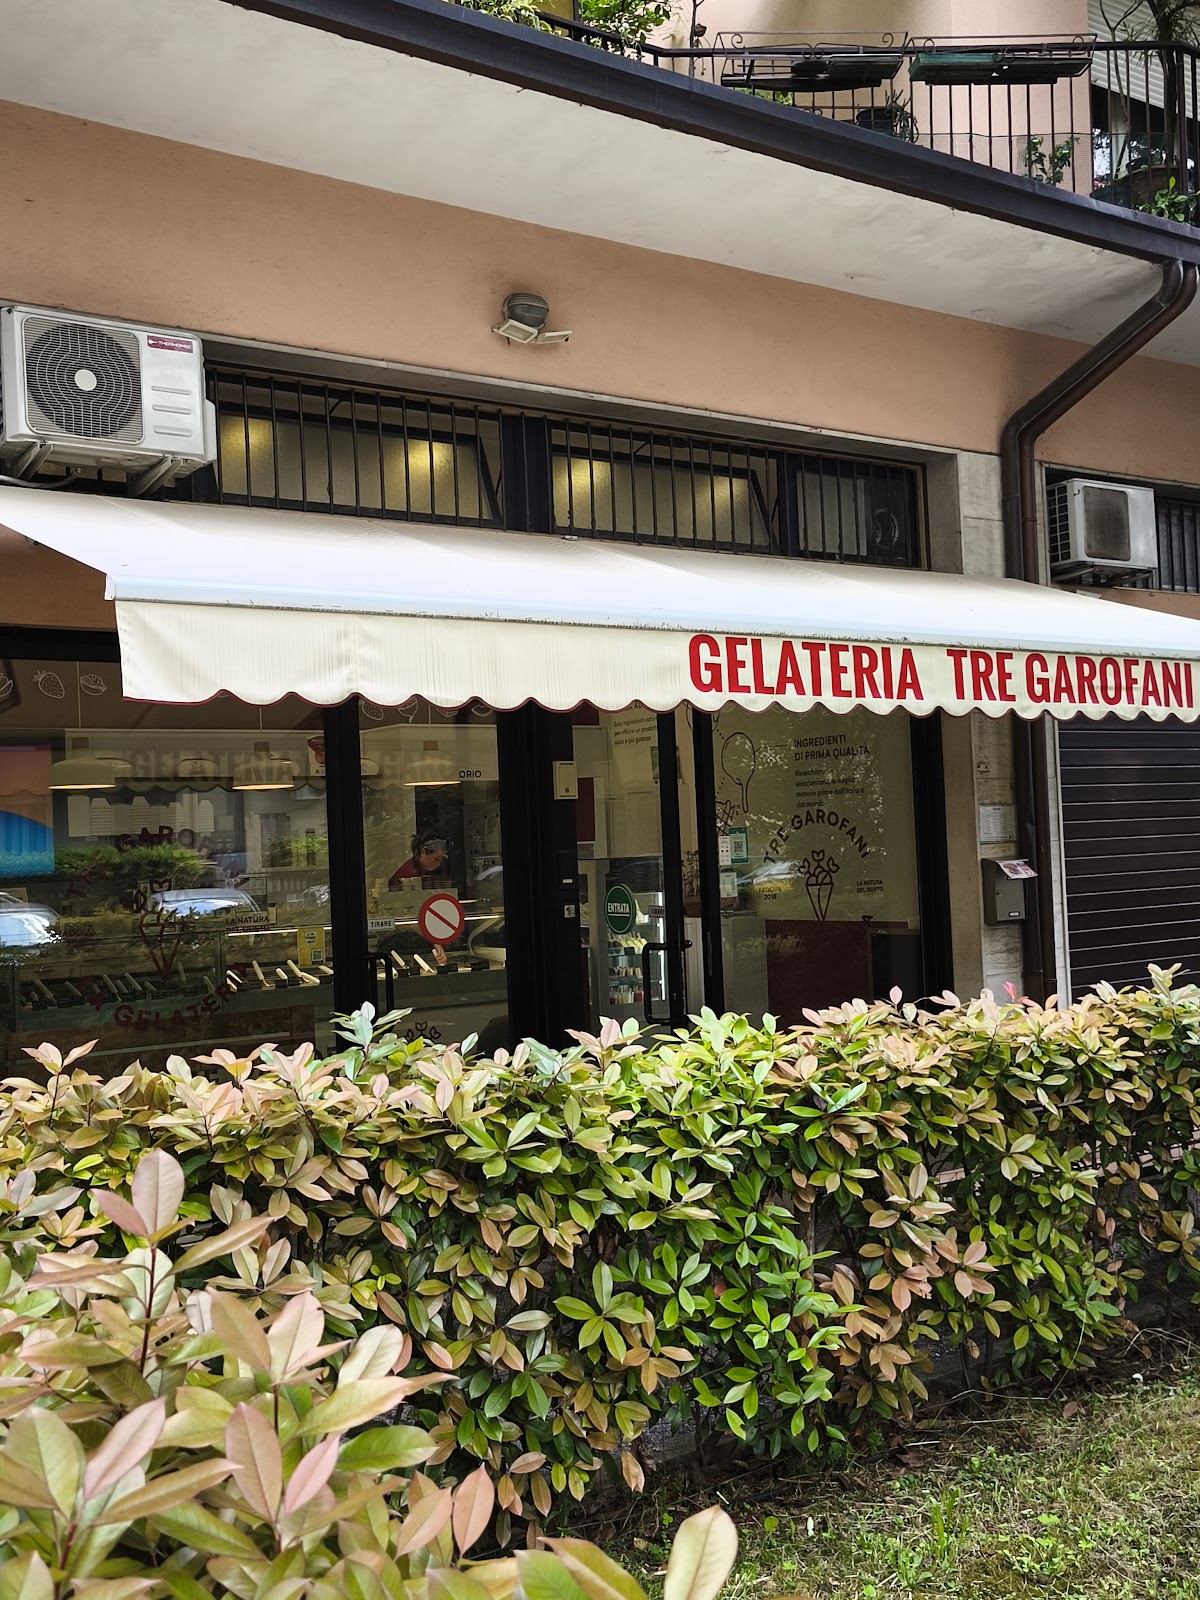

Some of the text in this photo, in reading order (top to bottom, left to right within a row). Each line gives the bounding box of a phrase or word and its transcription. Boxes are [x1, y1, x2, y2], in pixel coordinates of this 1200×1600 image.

[688, 633, 1195, 709] GELATERIA TRE GAROFANI
[793, 734, 846, 749] INGREDIENTI
[794, 742, 871, 762] DI PRIMA QUALITÀ
[458, 769, 482, 779] ORIO
[763, 826, 790, 864] TRE
[790, 808, 871, 859] GAROFANI
[864, 879, 884, 887] NATURA
[758, 886, 782, 894] PADOVA
[866, 886, 884, 894] GUSTO
[763, 893, 777, 901] 2018
[607, 902, 630, 914] ENTRATA
[237, 915, 270, 924] NATURA
[370, 920, 392, 928] TIRARE
